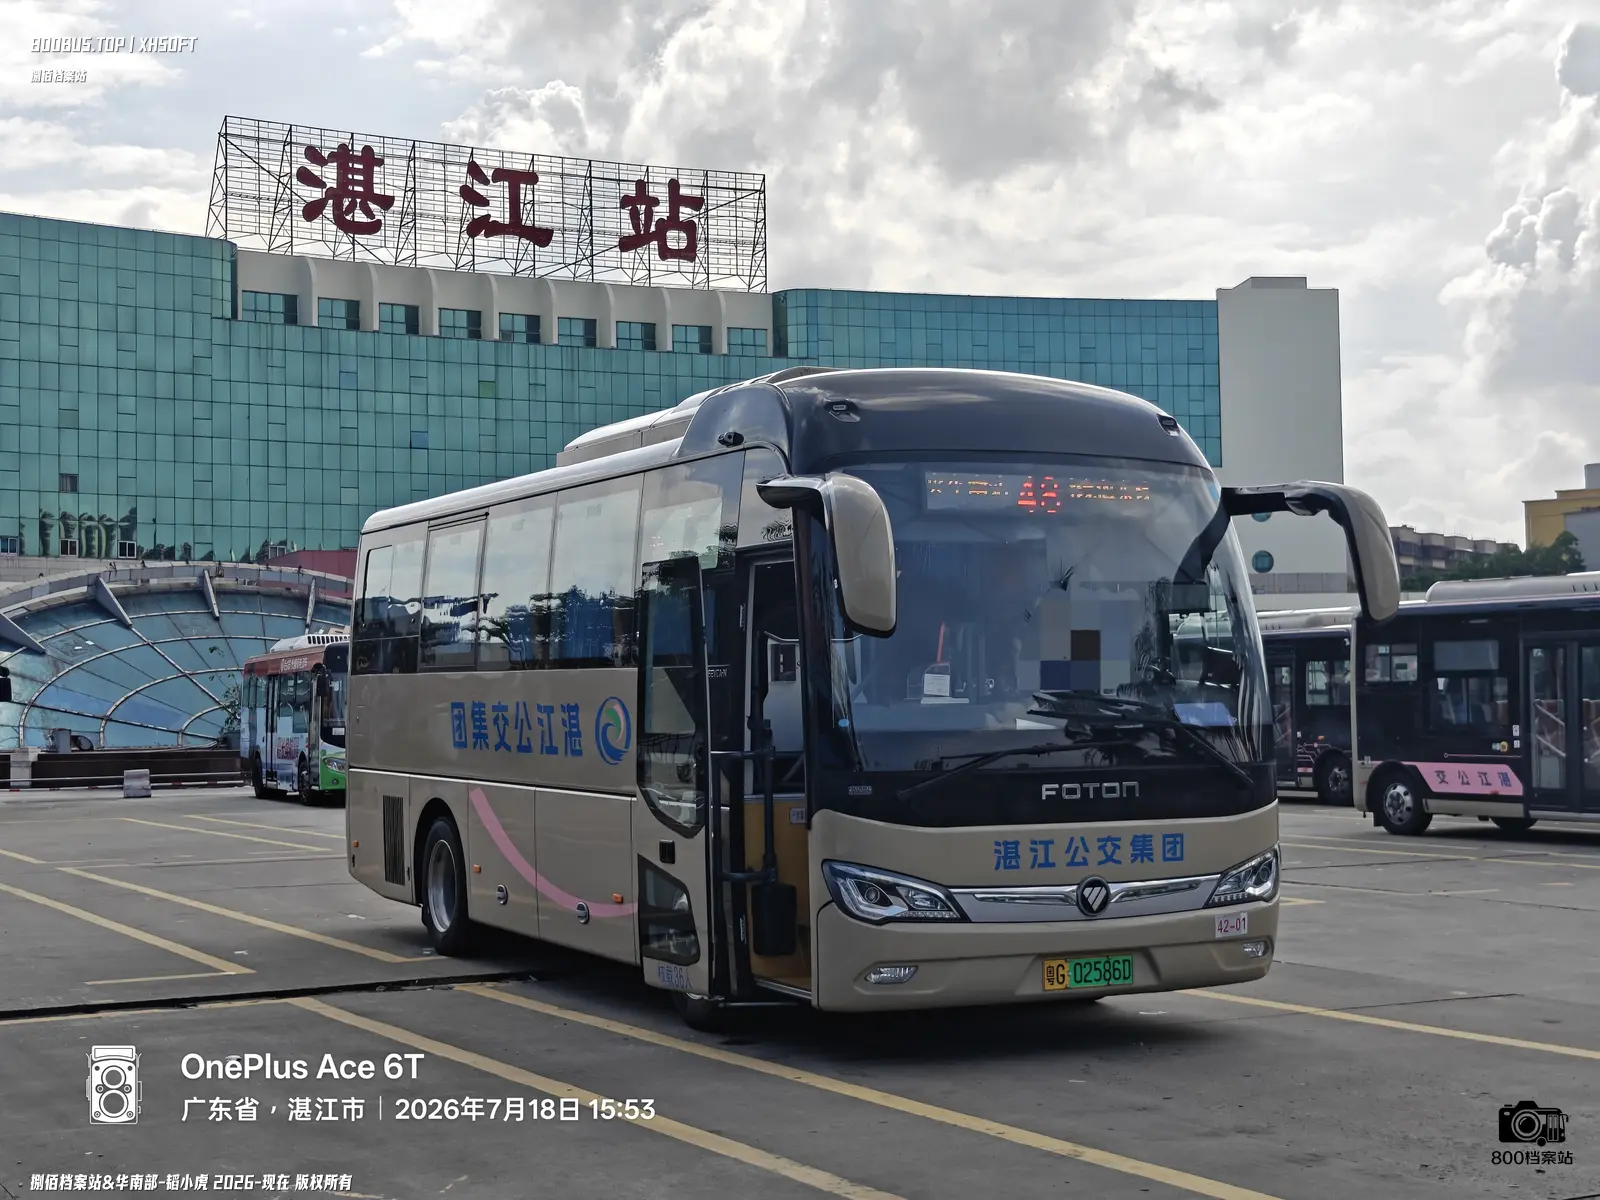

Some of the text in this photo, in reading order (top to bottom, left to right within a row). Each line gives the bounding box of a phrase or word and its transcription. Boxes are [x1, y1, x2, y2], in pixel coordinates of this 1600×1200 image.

[296, 143, 705, 262] 湛江站
[1041, 781, 1140, 801] FOTON
[993, 832, 1185, 872] 湛江公交集团
[1217, 916, 1247, 934] 42-01
